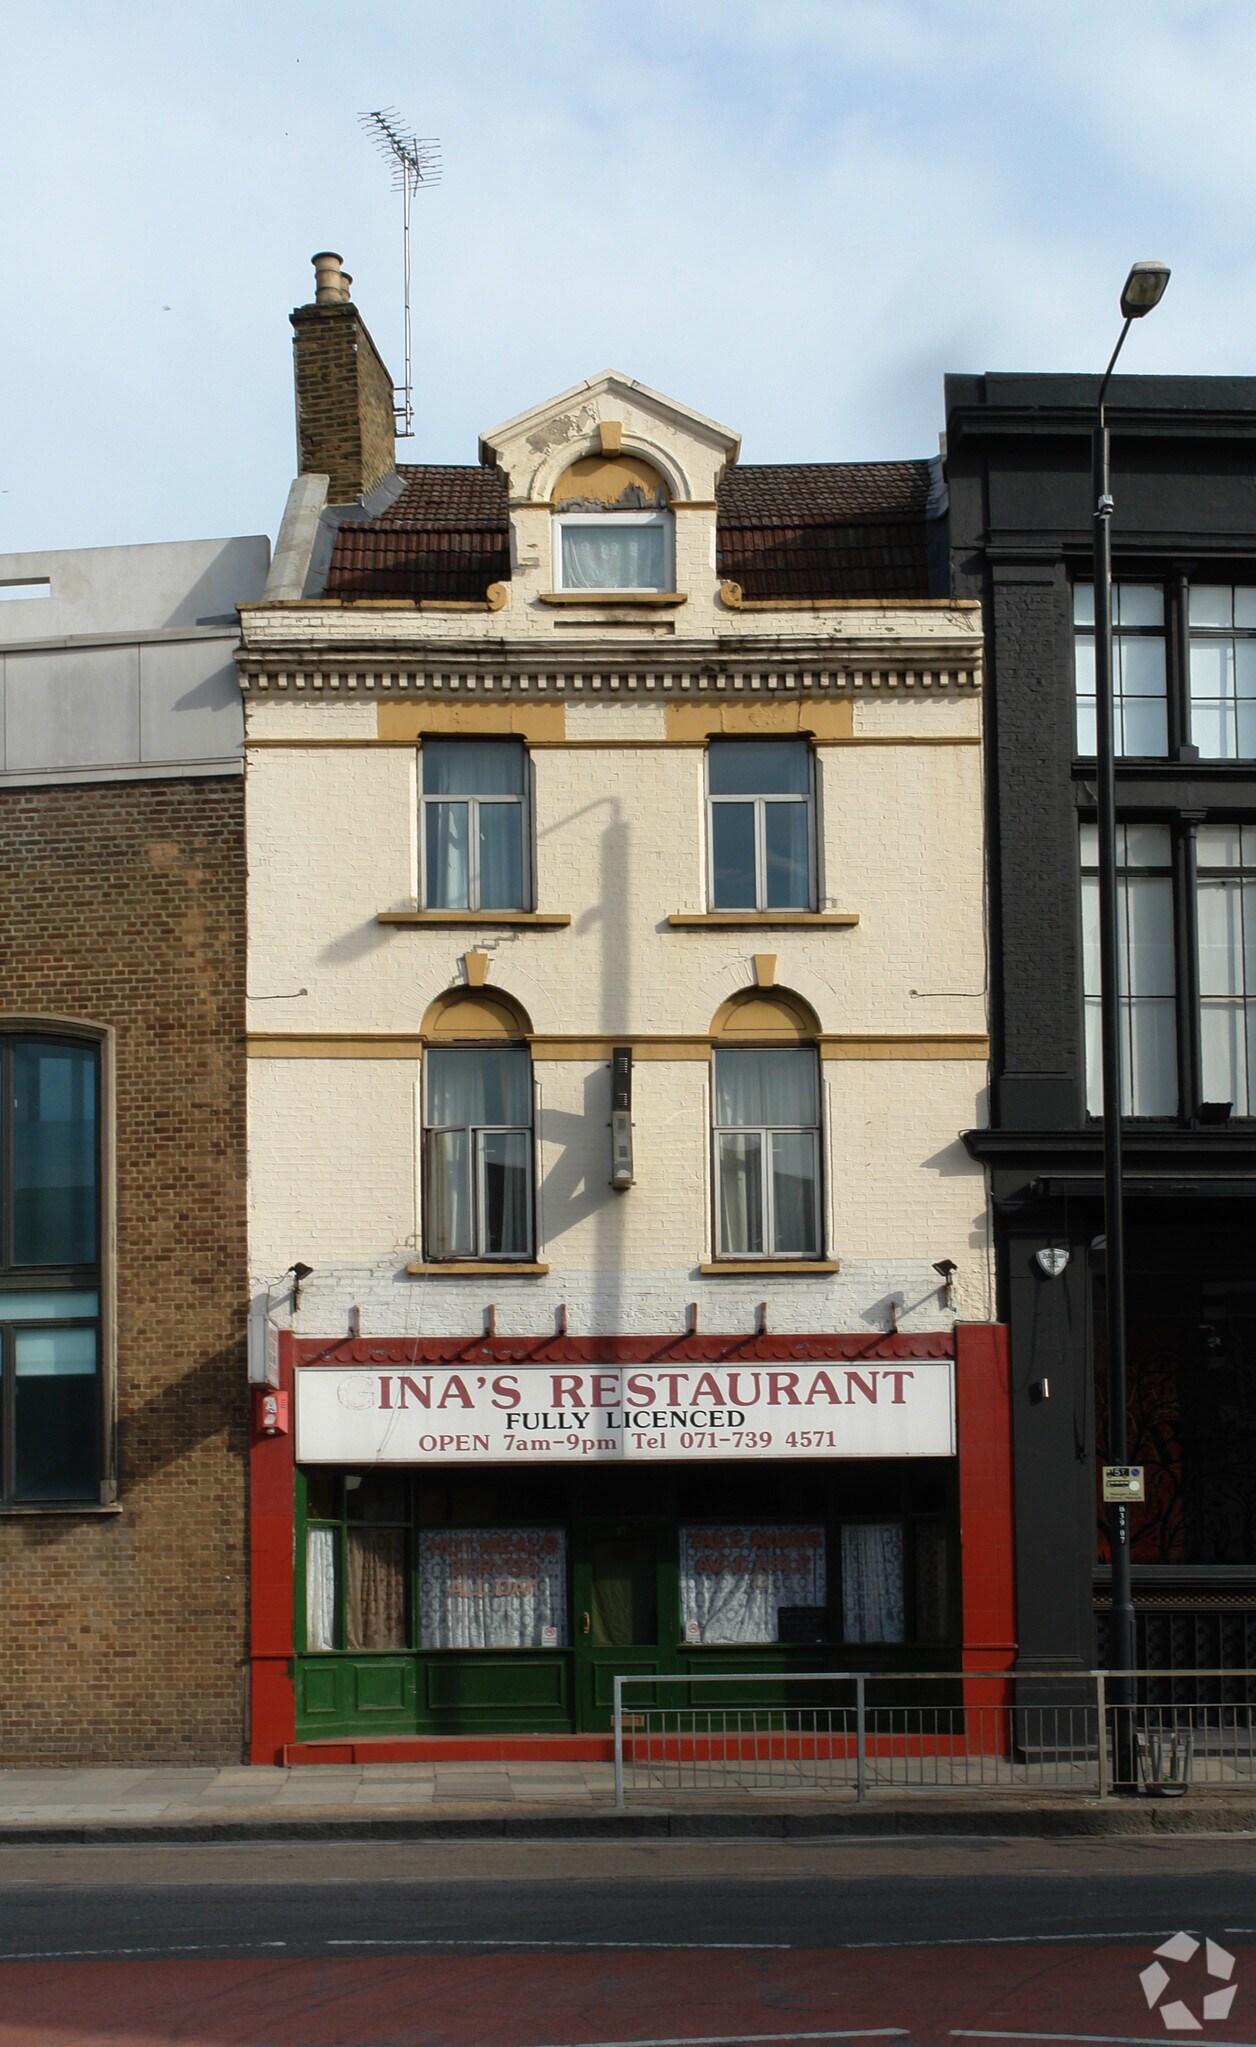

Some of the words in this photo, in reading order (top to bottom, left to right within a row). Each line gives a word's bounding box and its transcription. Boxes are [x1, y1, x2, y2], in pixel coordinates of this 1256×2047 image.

[550, 1370, 914, 1410] RESTAURANT
[506, 1412, 590, 1430] FULLY
[606, 1410, 745, 1429] LICENCED
[418, 1434, 490, 1451] OPEN
[503, 1433, 617, 1454] 7am-9pm
[631, 1432, 666, 1449] Tel
[680, 1431, 772, 1449] 071-739
[785, 1430, 837, 1448] 4571
[479, 1535, 559, 1554] MEALS
[448, 1578, 491, 1598] ALL
[495, 1578, 539, 1597] DAY
